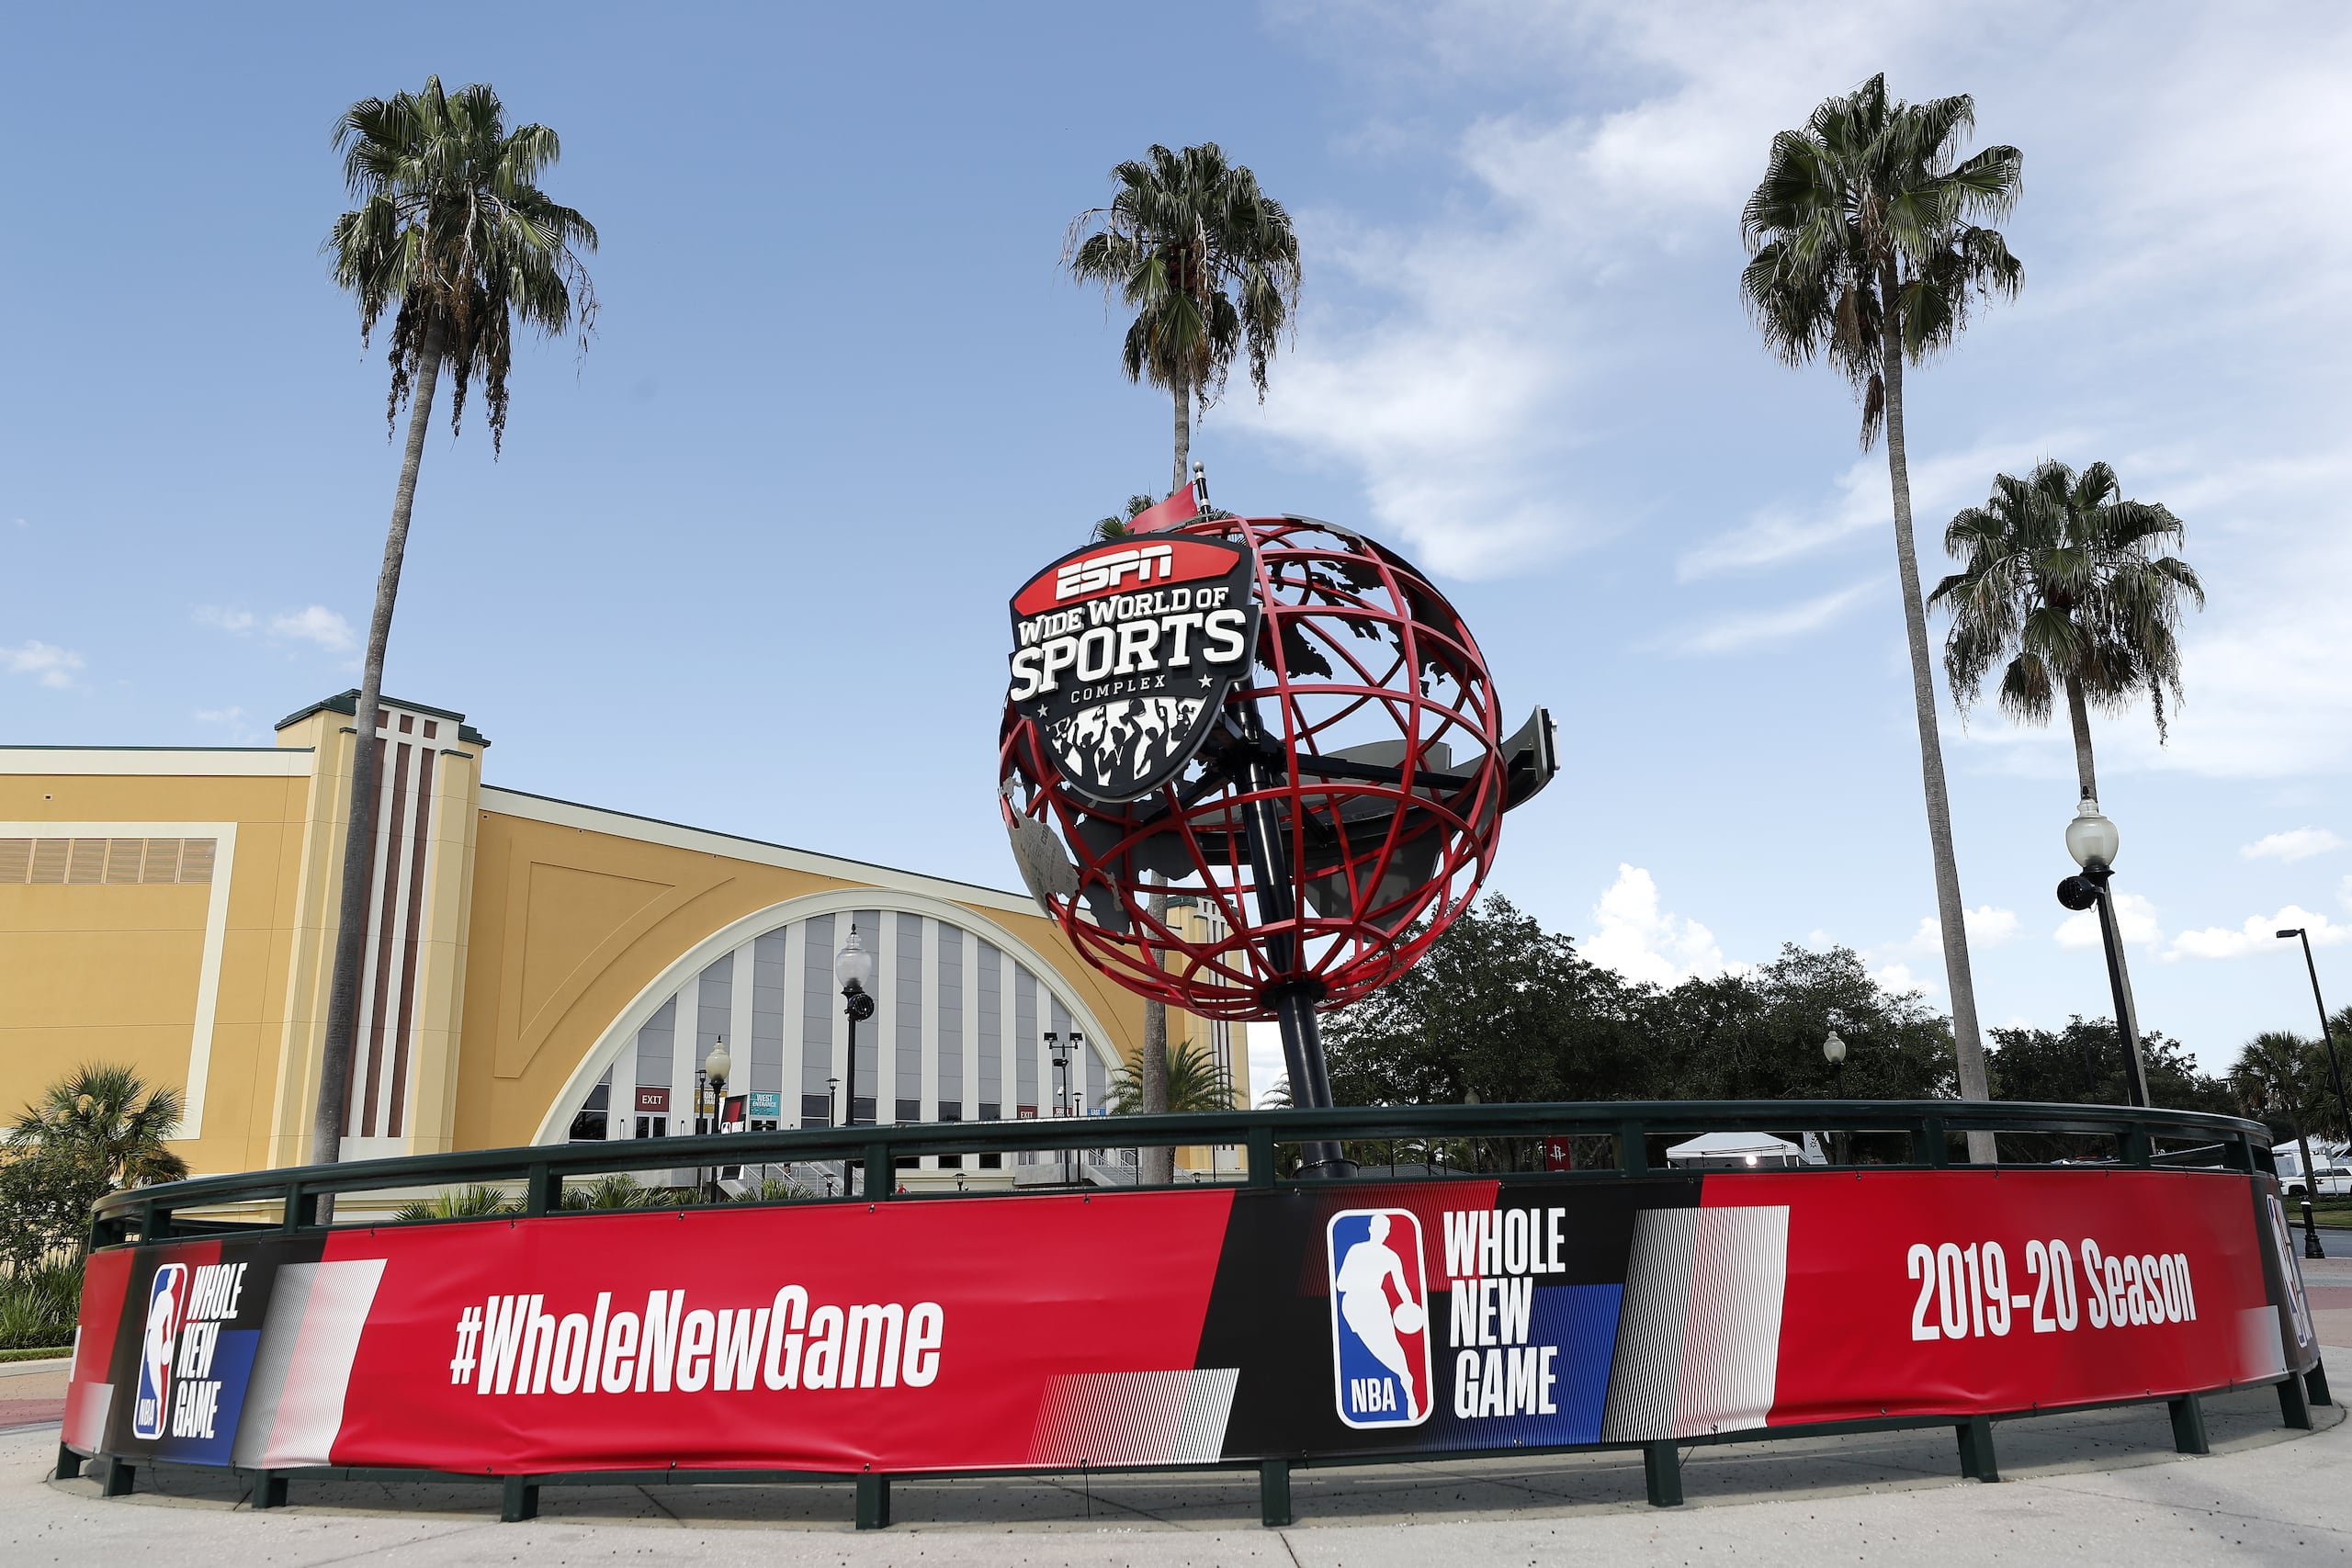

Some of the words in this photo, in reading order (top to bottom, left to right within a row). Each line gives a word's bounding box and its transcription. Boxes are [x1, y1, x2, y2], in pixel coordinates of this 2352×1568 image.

[1056, 545, 1173, 601] ESPN
[1018, 606, 1085, 647] WIDE
[1087, 588, 1192, 626] WORLD
[1195, 586, 1229, 610] OF
[1010, 609, 1247, 702] SPORTS
[1070, 674, 1166, 704] COMPLEX
[641, 1094, 663, 1105] EXIT
[756, 1093, 774, 1102] WEST
[1020, 1111, 1034, 1119] EXIT
[1443, 1208, 1566, 1277] WHOLE
[186, 1262, 248, 1320] WHOLE
[1450, 1277, 1533, 1348] NEW
[1906, 1239, 2079, 1341] 2019-20
[2080, 1237, 2198, 1330] Season
[175, 1321, 221, 1379] NEW
[449, 1283, 944, 1396] #WholeNewGame
[172, 1380, 222, 1439] GAME
[1351, 1377, 1397, 1413] NBA
[1453, 1346, 1558, 1419] GAME
[138, 1398, 155, 1427] NBA
